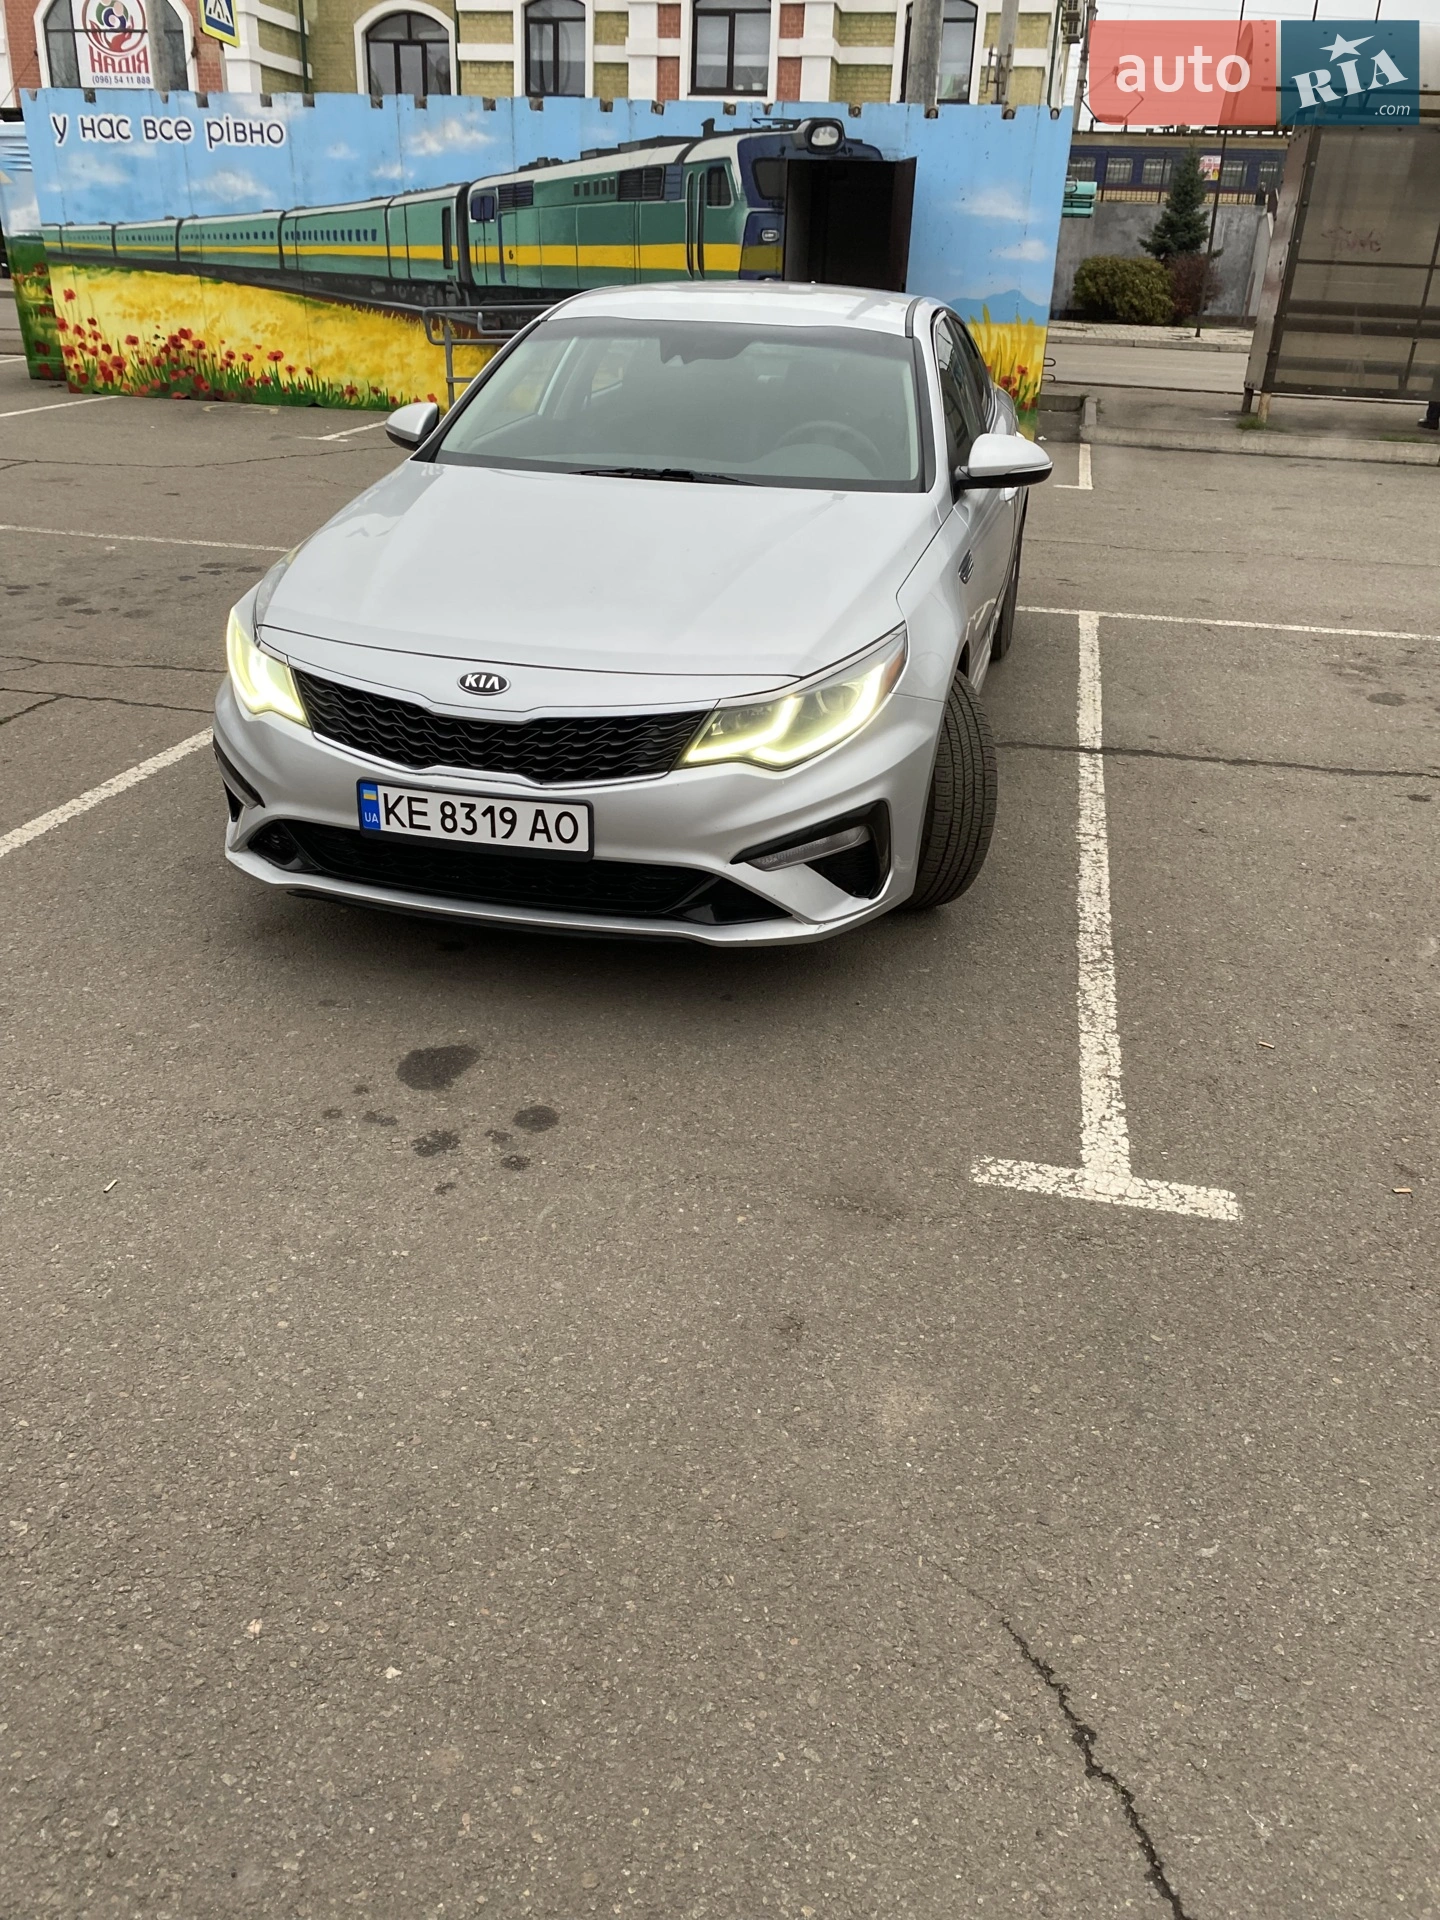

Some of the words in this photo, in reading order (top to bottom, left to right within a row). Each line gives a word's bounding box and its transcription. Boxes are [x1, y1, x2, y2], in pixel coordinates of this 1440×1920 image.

[89, 44, 149, 74] НАДІЯ
[92, 75, 112, 85] (096)
[114, 75, 124, 84] 54
[126, 75, 134, 84] 11
[136, 75, 151, 85] 888
[80, 116, 131, 141] нас
[143, 118, 192, 141] все
[206, 115, 284, 150] рівно
[464, 673, 500, 690] KIA
[364, 812, 379, 823] UA
[383, 793, 431, 831] KE
[440, 800, 517, 839] 8319
[529, 809, 579, 844] AO
